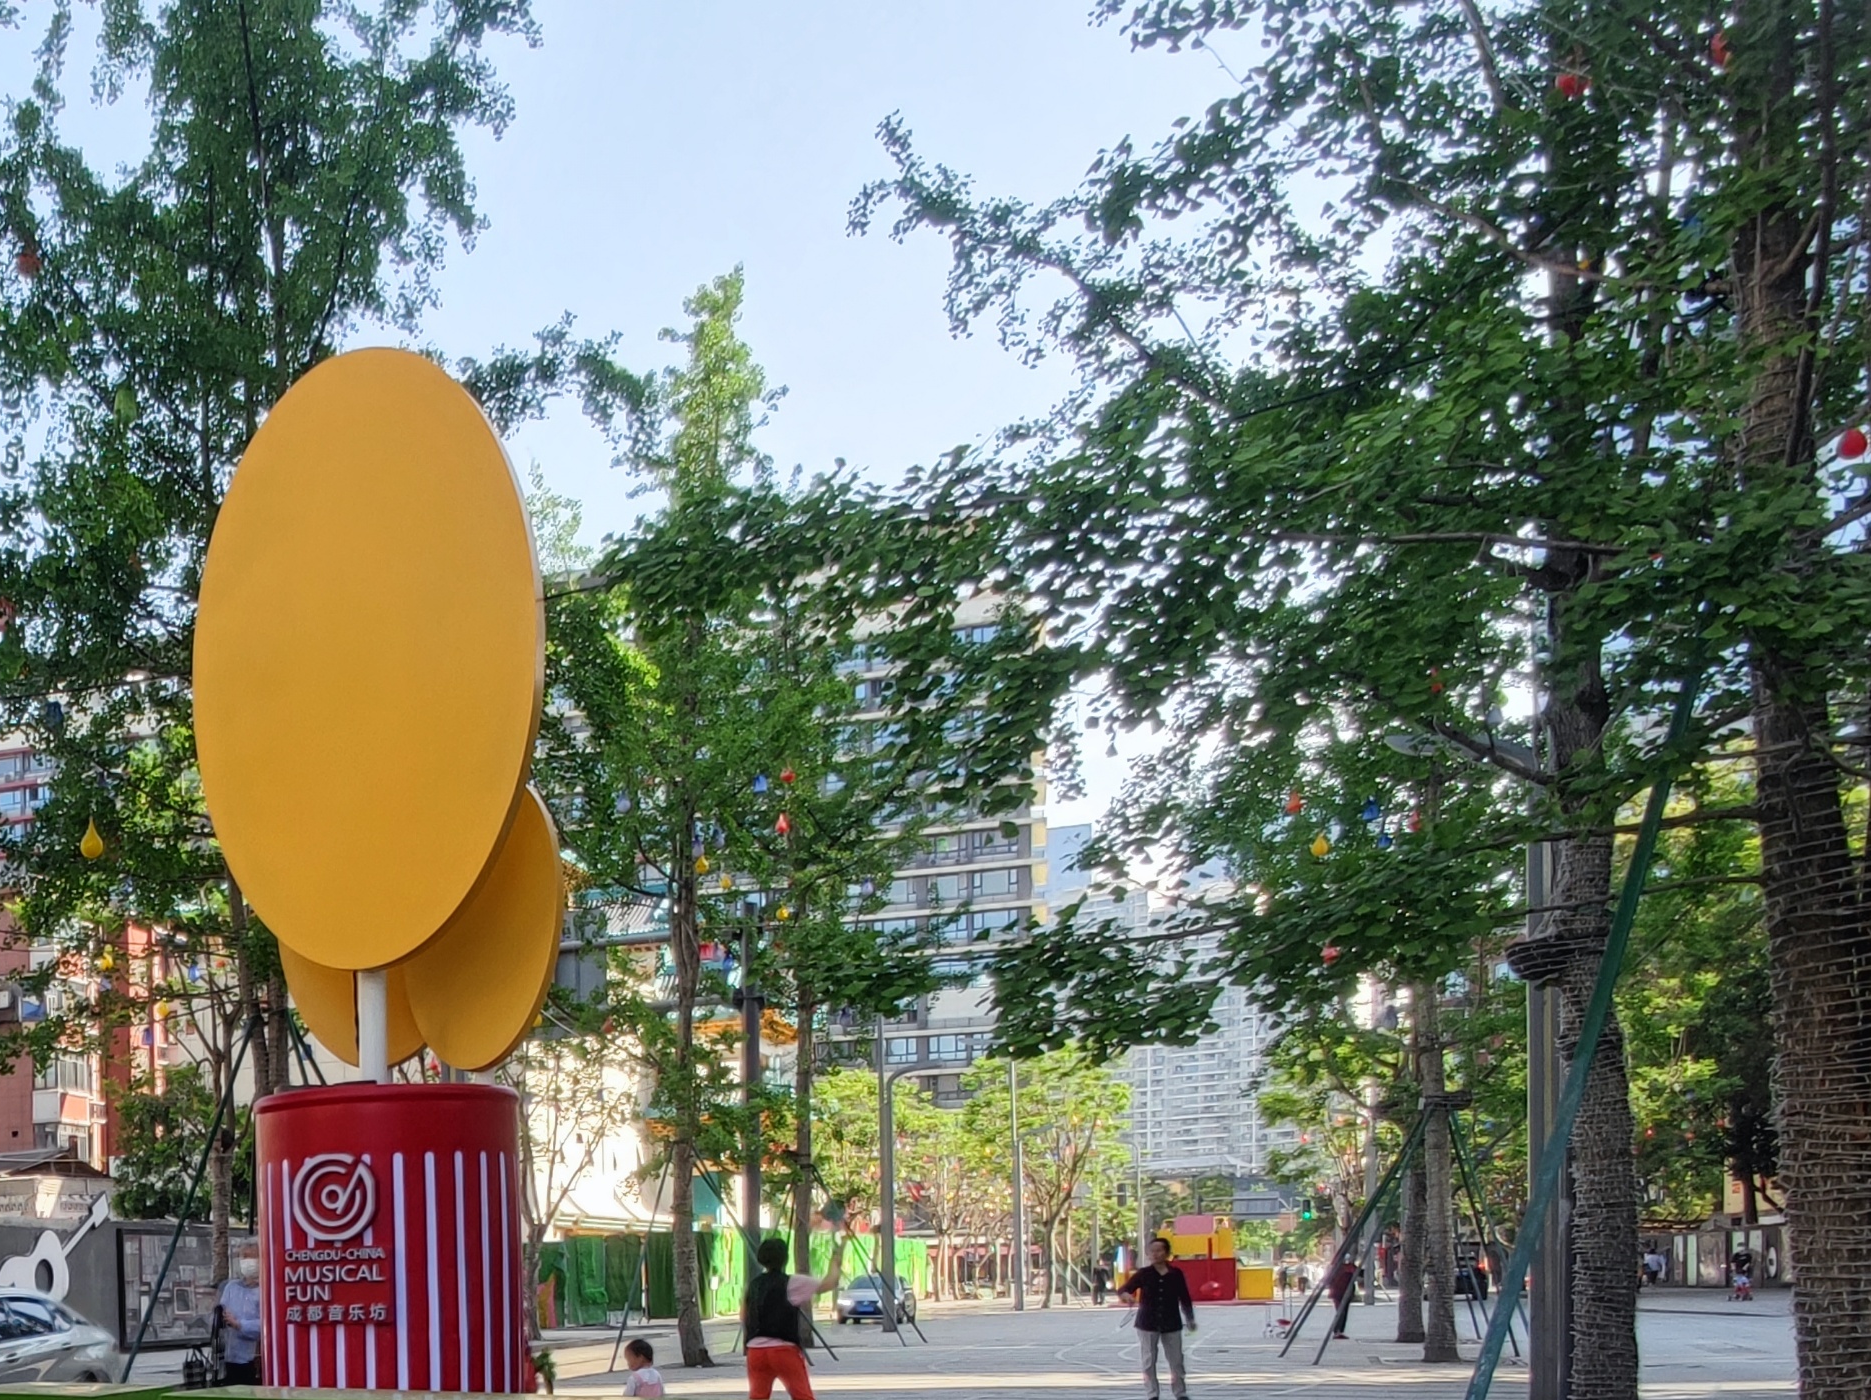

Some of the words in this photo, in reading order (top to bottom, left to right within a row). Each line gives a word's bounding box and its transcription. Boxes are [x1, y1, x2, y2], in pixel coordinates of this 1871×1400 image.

[285, 1247, 386, 1261] CHENGDU-CHINA
[284, 1264, 386, 1283] MUSICAL
[285, 1284, 331, 1302] FUN
[286, 1303, 387, 1322] 成都音乐坊
